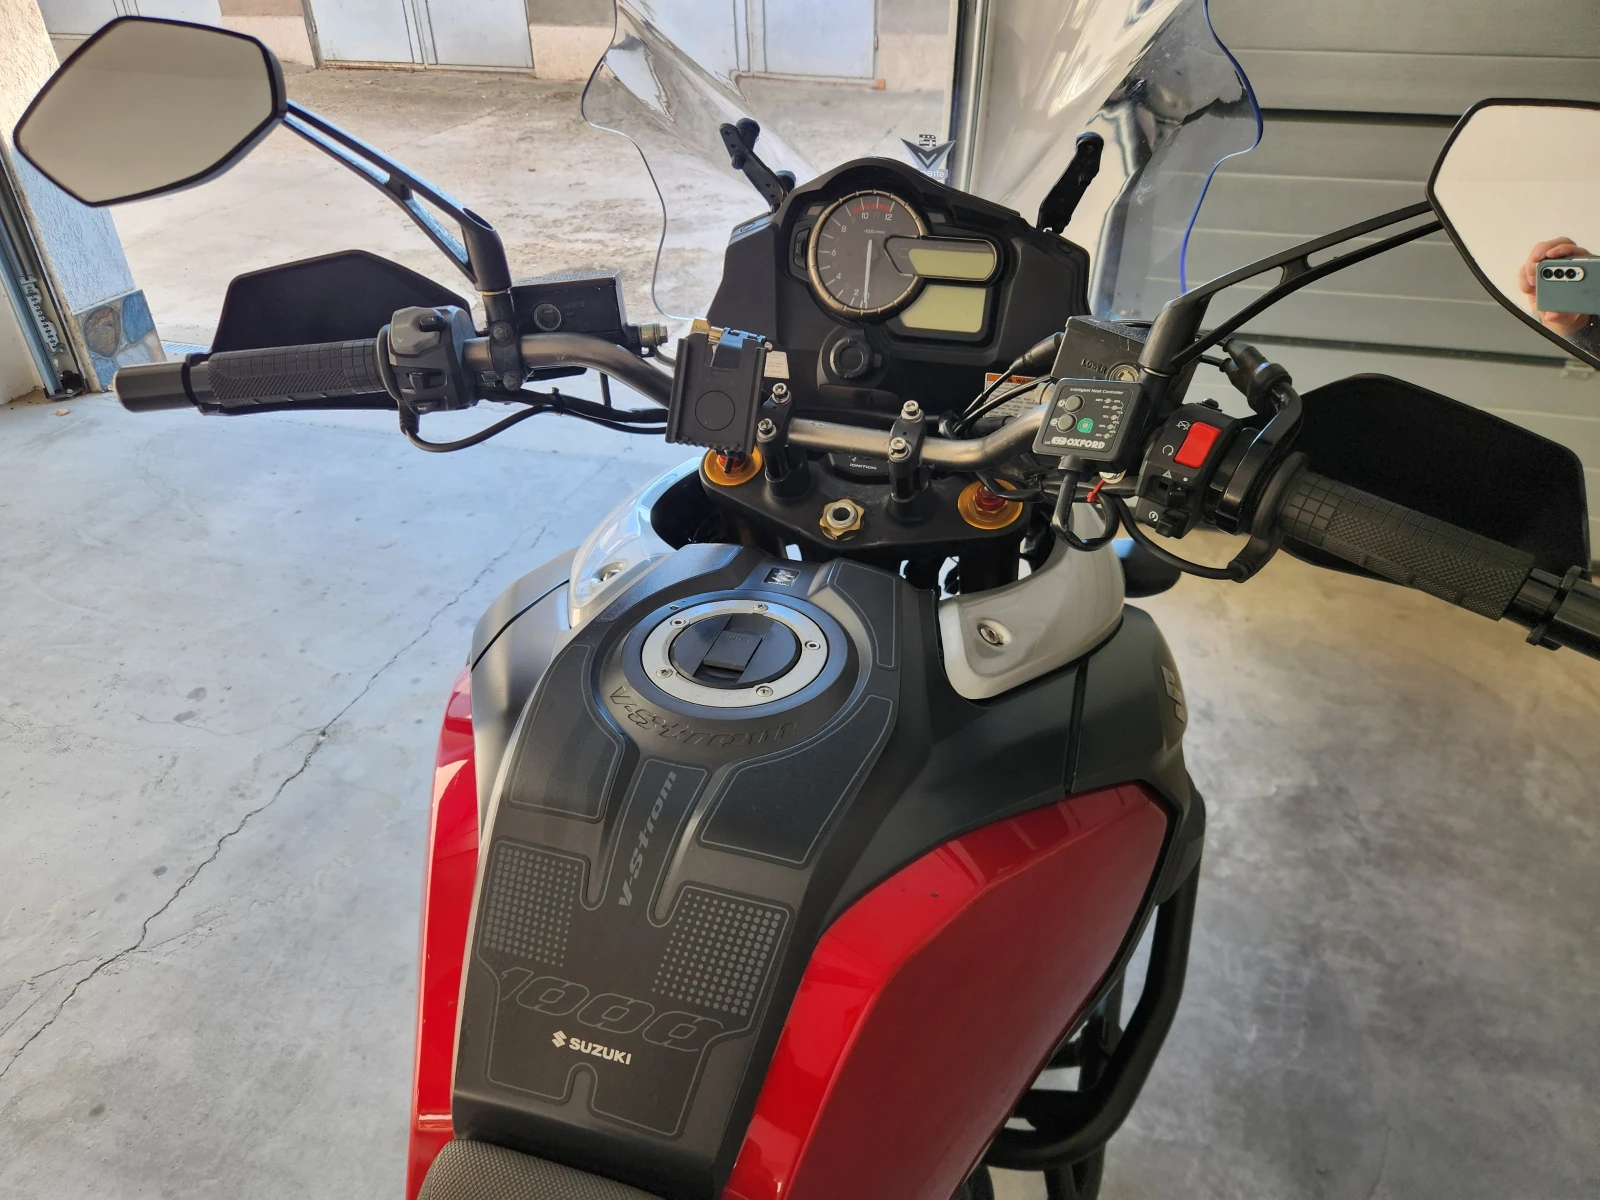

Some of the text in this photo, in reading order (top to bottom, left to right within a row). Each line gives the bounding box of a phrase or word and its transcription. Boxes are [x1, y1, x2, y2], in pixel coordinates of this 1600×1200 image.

[885, 213, 893, 221] 12
[1081, 358, 1107, 375] LOWER
[1066, 438, 1106, 449] OXFORD
[618, 770, 678, 907] V-Strom
[568, 1036, 632, 1065] SUZUKI
